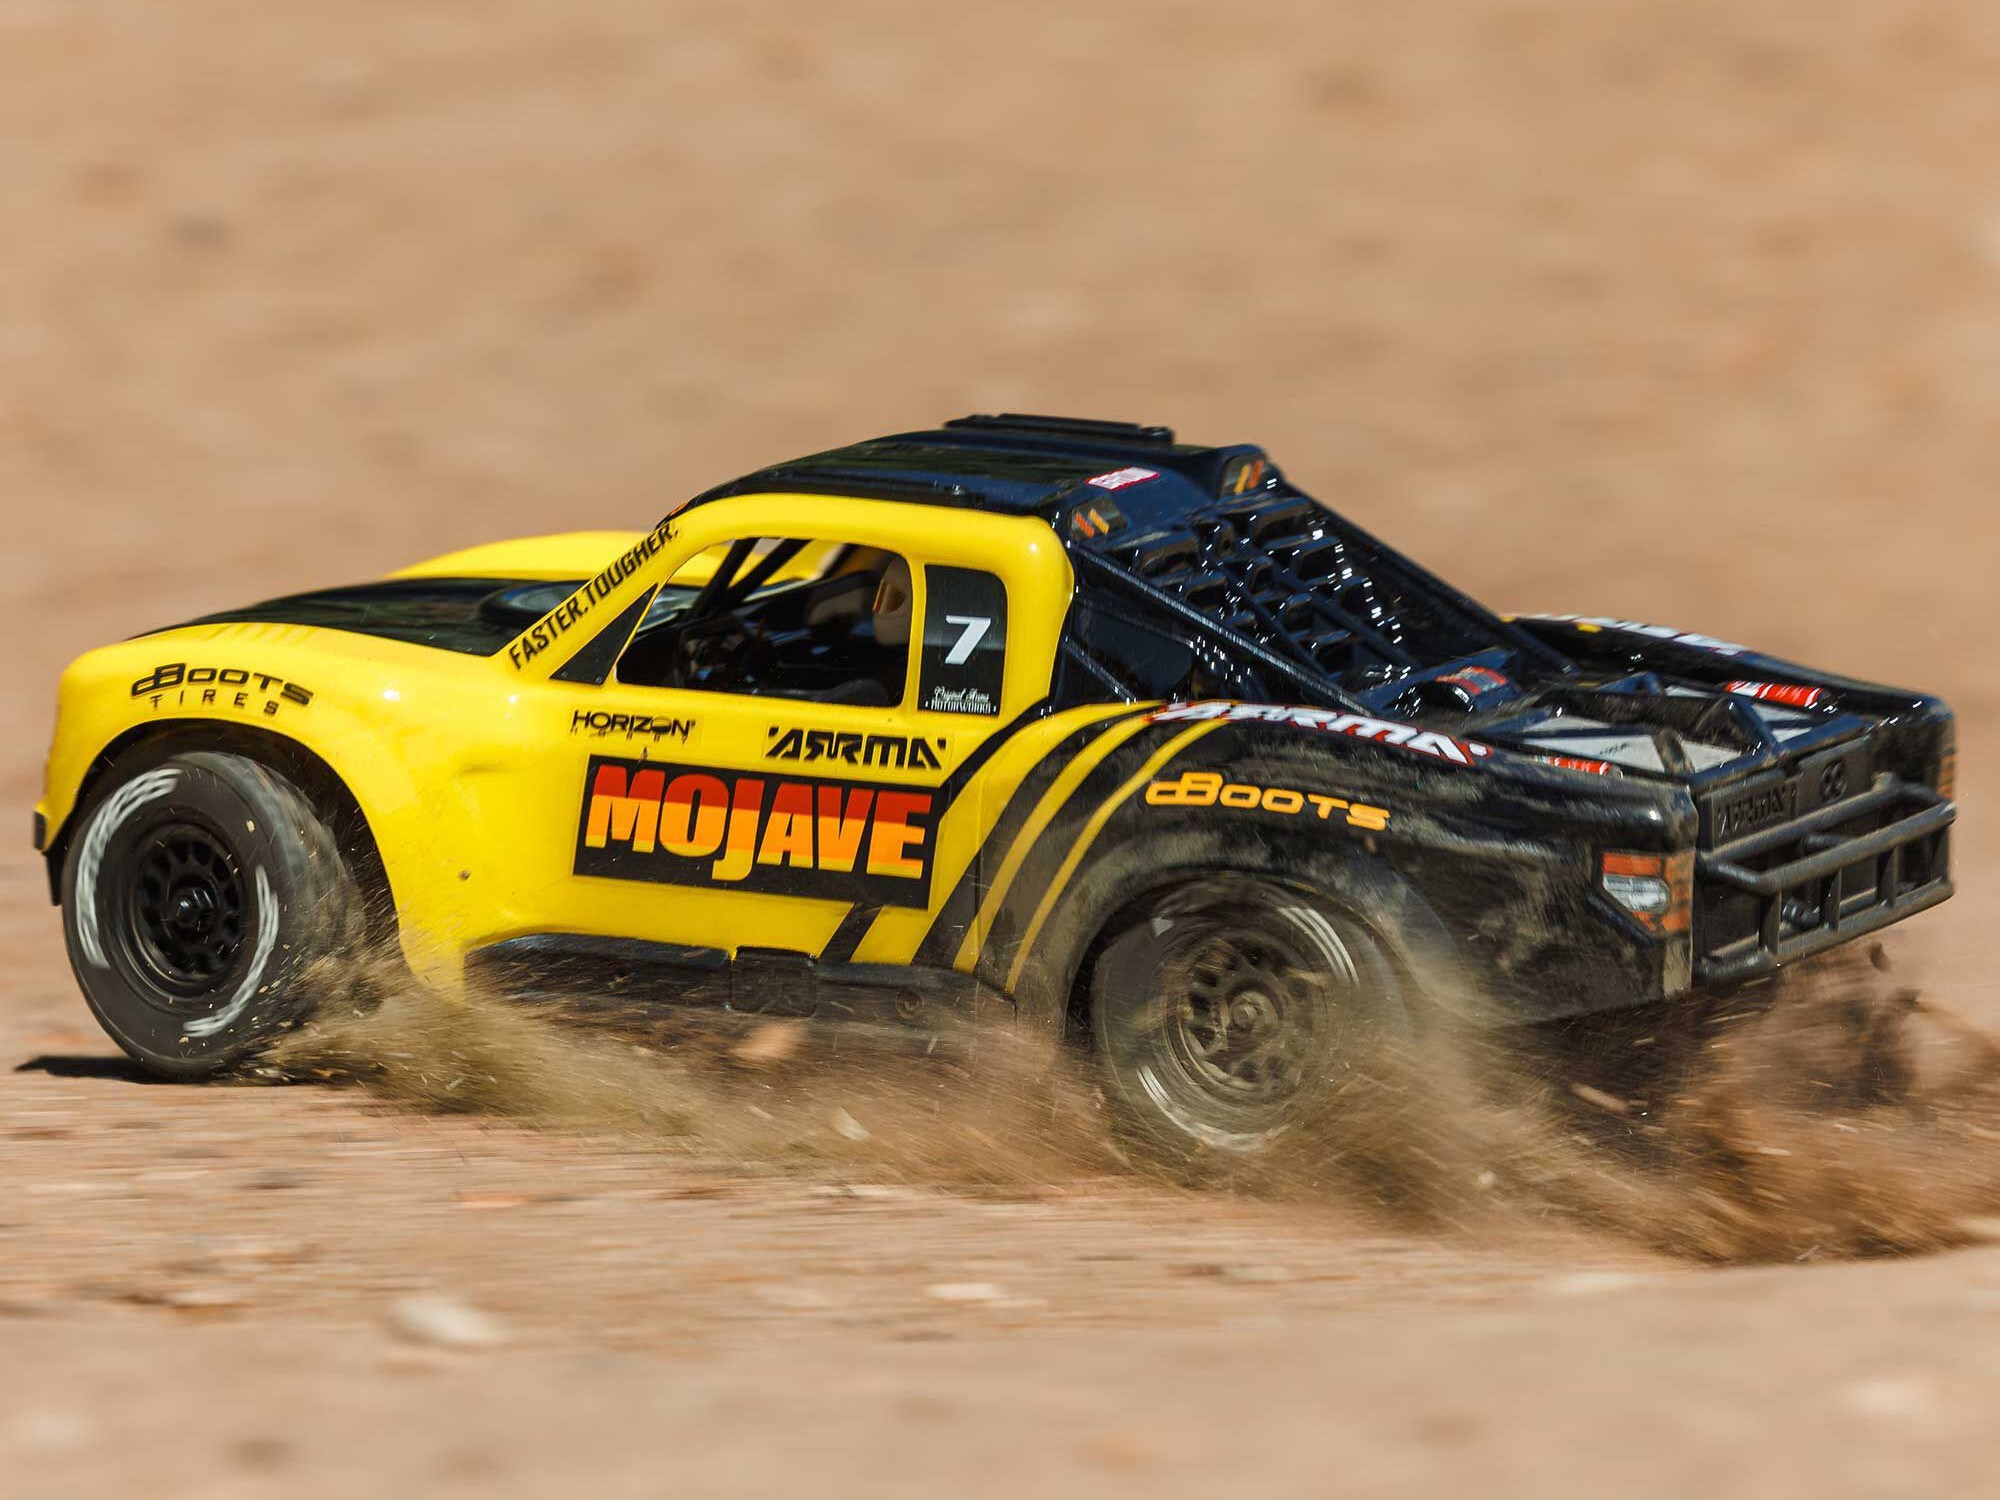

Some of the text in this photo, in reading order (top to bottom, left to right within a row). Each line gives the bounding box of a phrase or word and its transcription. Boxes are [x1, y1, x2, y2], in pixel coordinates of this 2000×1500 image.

[945, 615, 992, 665] 7
[151, 688, 280, 716] TIRES
[765, 726, 946, 770] ARRMA
[585, 764, 932, 881] MOJAVE
